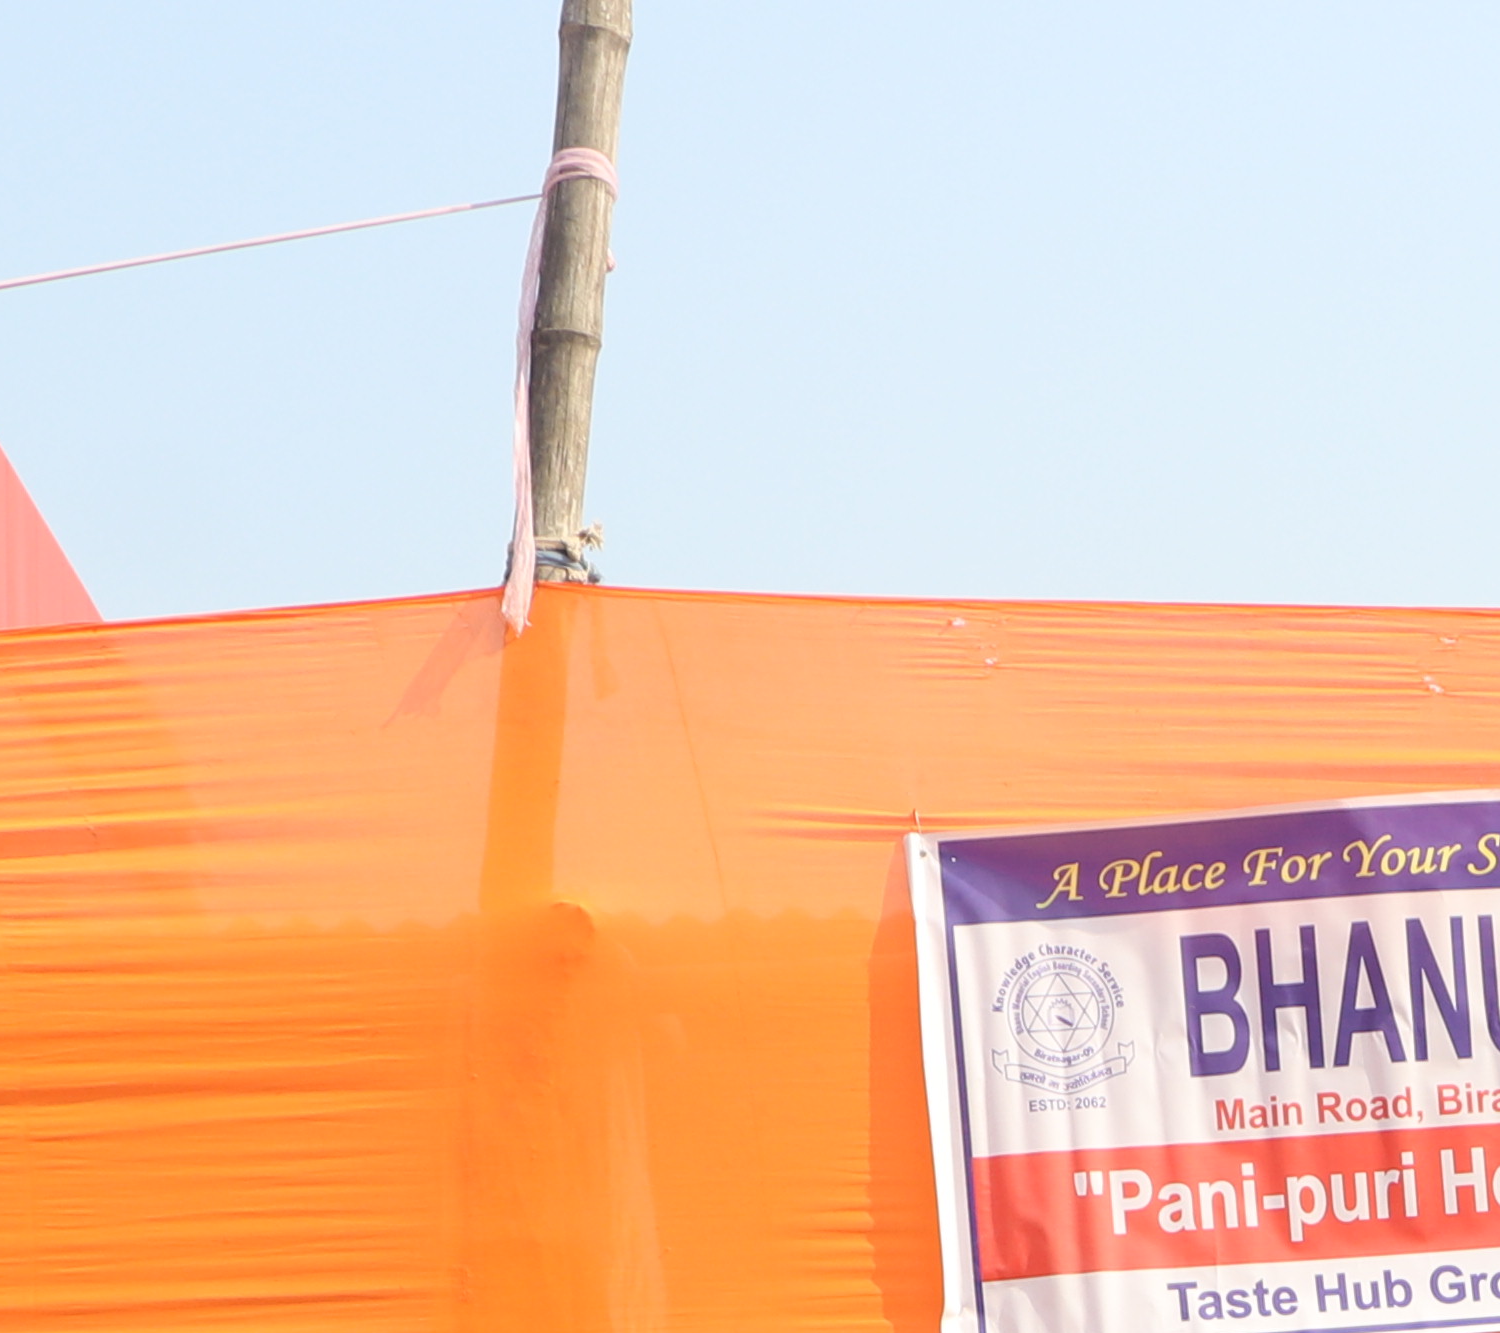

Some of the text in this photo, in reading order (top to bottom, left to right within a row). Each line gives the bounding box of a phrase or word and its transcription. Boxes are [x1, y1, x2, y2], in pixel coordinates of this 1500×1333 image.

[1036, 863, 1083, 908] A
[1100, 851, 1225, 897] Place
[1244, 847, 1332, 886] For
[1343, 835, 1461, 876] Your
[992, 943, 1124, 1013] Knowledge Character Service
[1028, 1096, 1108, 1113] ESTD: 2062
[1216, 1096, 1302, 1130] Main
[1317, 1088, 1422, 1123] Road,
[1074, 1152, 1417, 1241] "Pani-puri
[1167, 1280, 1297, 1321] Taste
[1315, 1270, 1412, 1312] Hub
